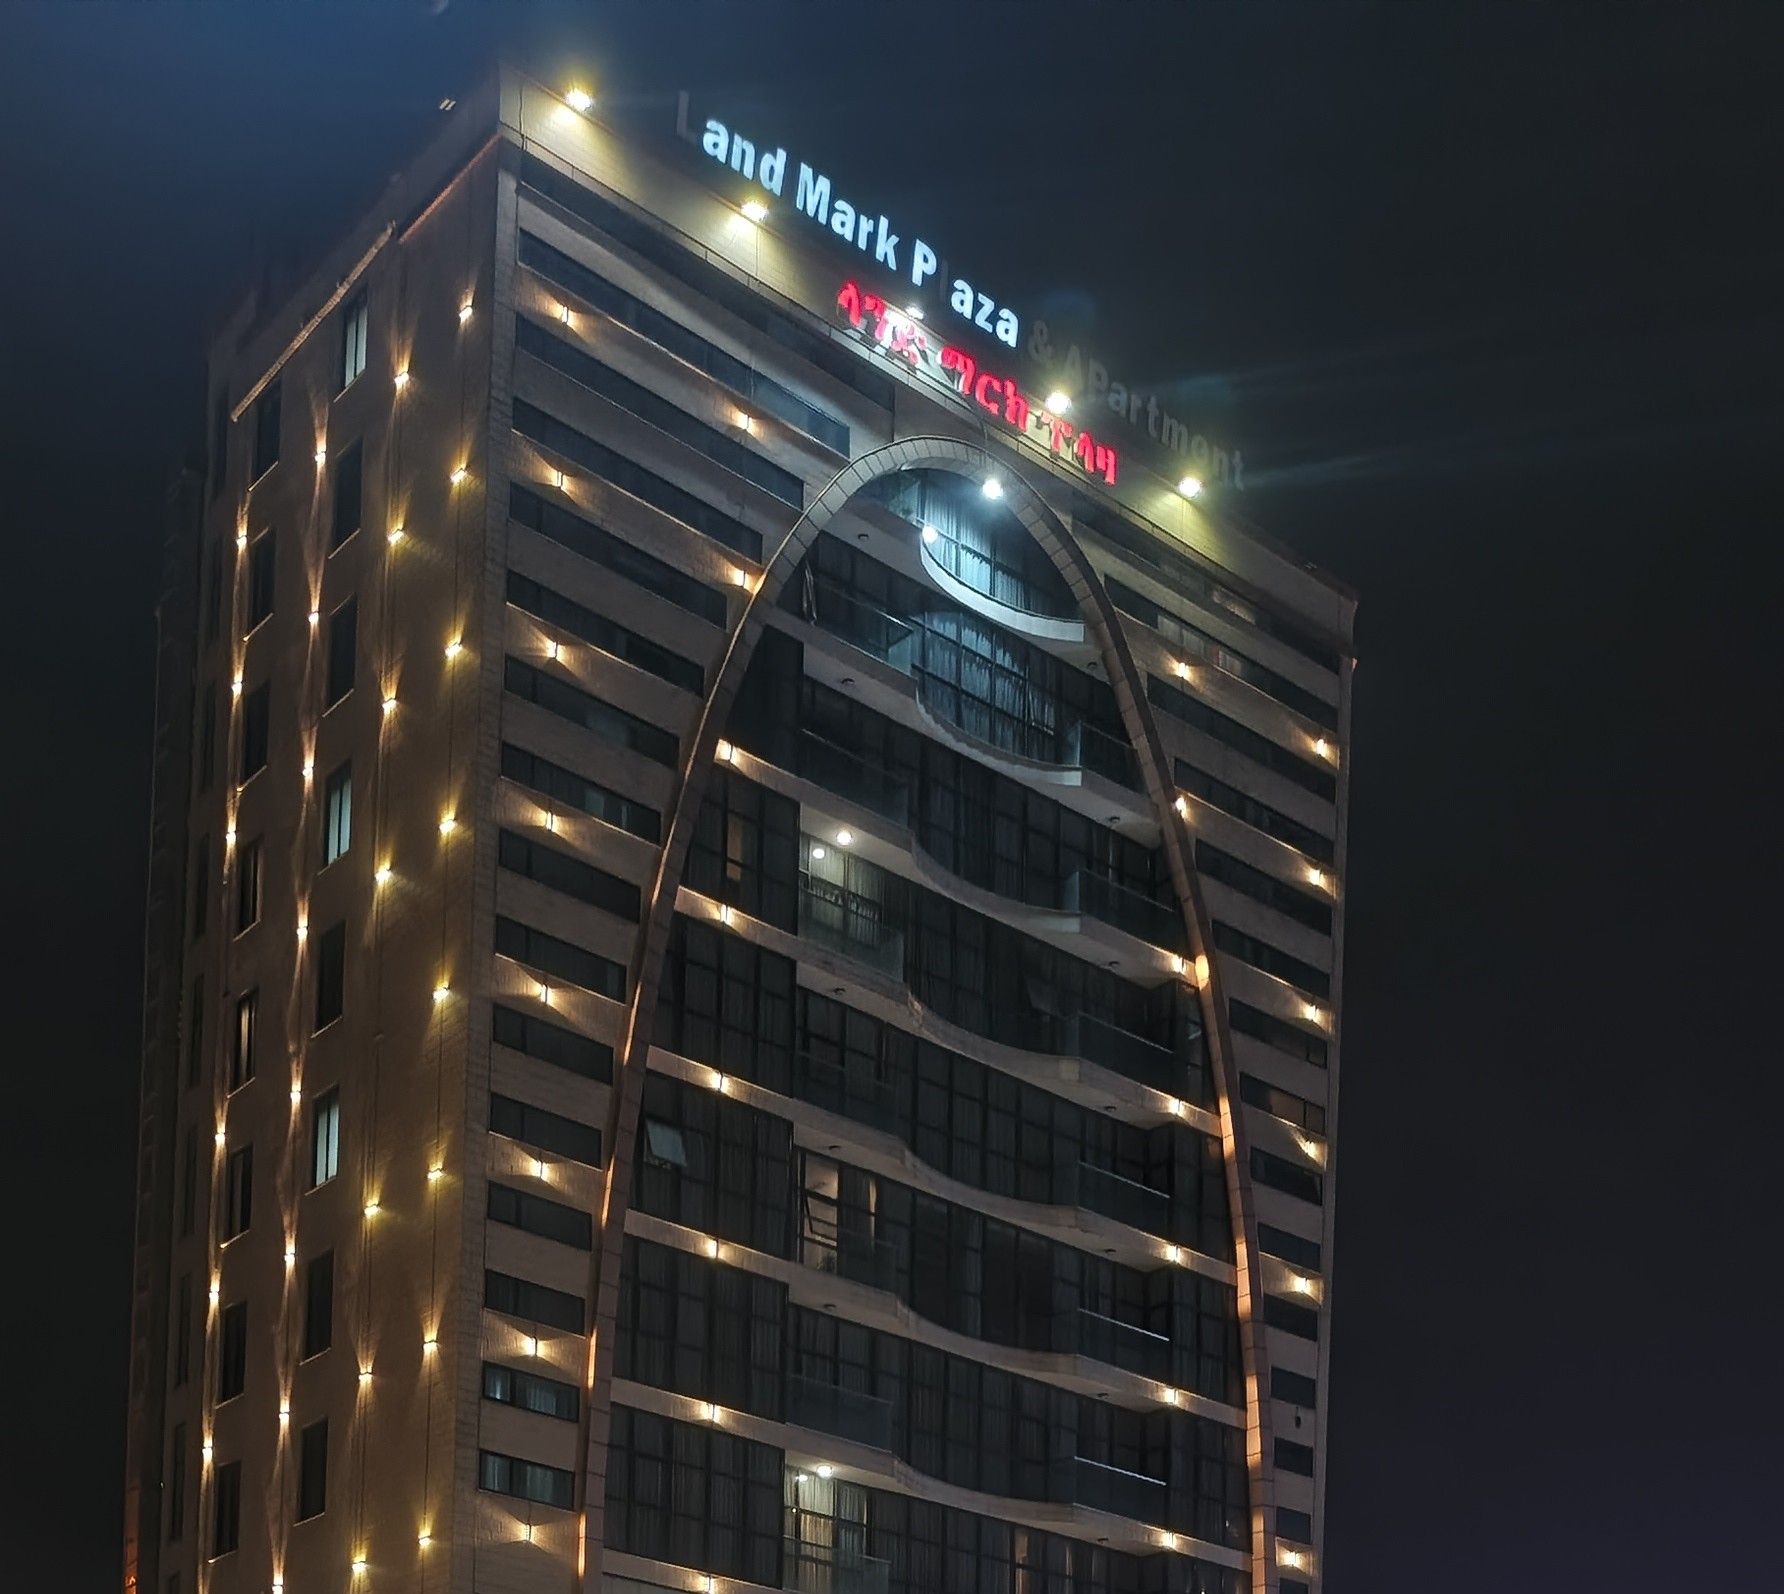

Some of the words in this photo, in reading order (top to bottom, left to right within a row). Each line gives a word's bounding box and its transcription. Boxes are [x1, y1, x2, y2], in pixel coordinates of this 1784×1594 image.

[676, 89, 787, 197] Land
[796, 161, 900, 271] Mark
[911, 238, 1019, 348] Plaza
